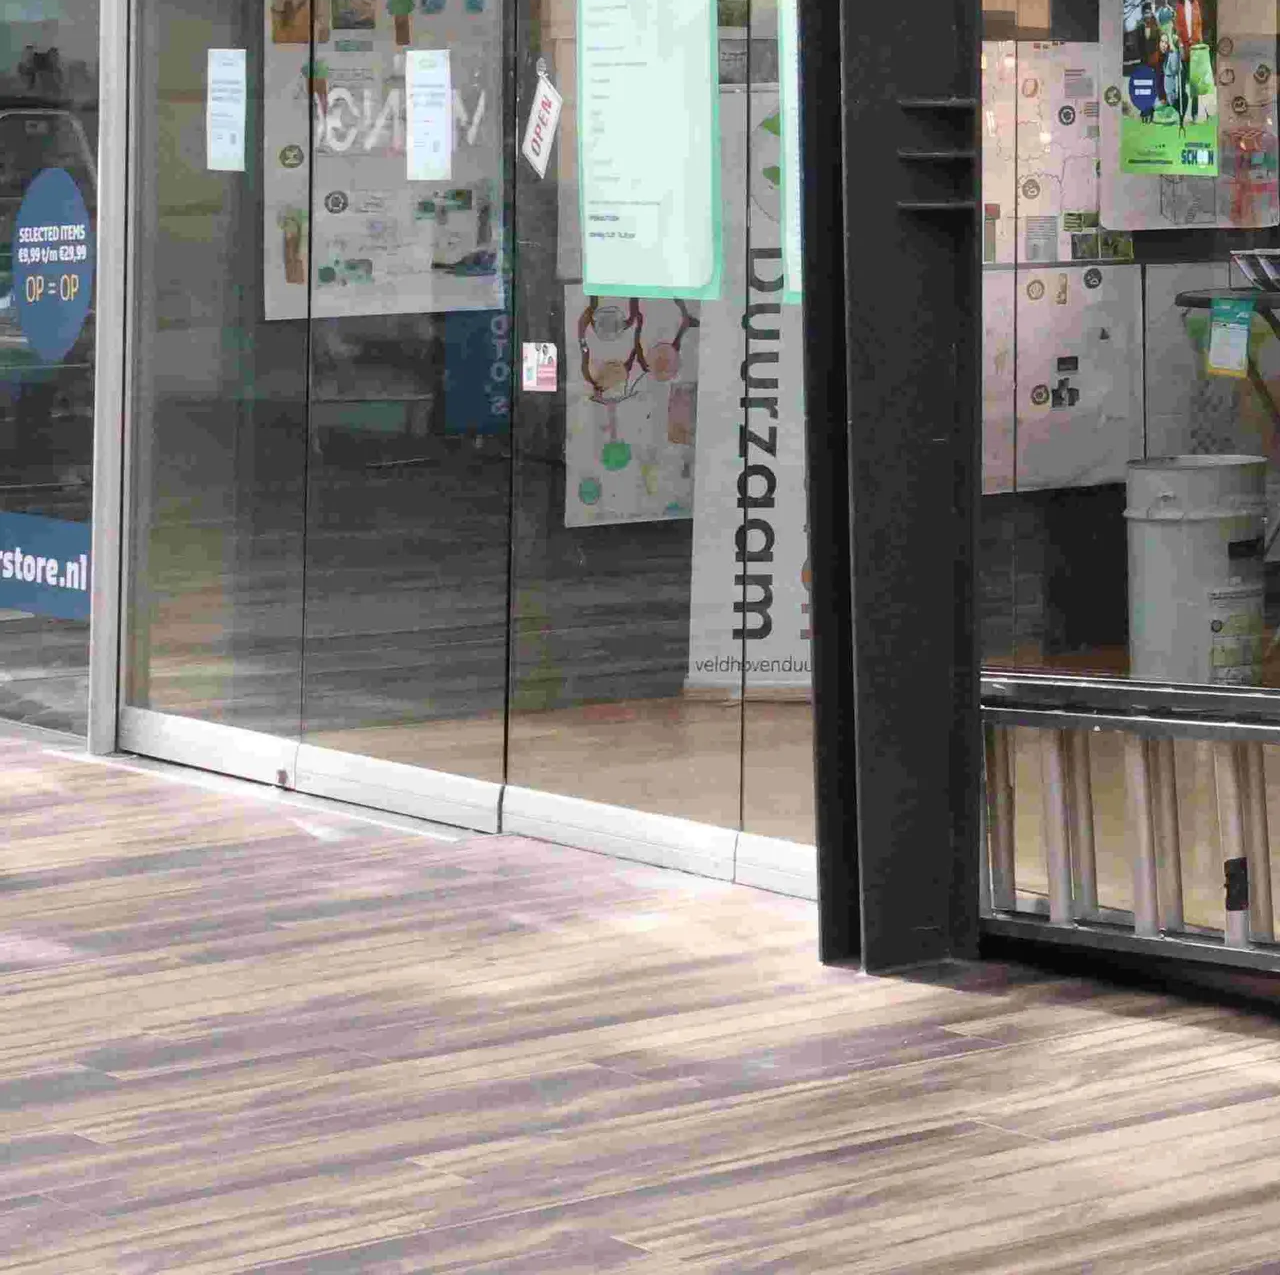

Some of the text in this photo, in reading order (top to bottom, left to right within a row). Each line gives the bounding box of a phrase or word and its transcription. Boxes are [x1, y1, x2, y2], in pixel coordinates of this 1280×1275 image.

[530, 93, 553, 158] OPEN
[19, 224, 86, 243] SELECTED ITEMS
[41, 246, 58, 264] t/m
[26, 275, 44, 302] OP
[60, 273, 79, 301] OP
[732, 247, 784, 640] Duurzaam
